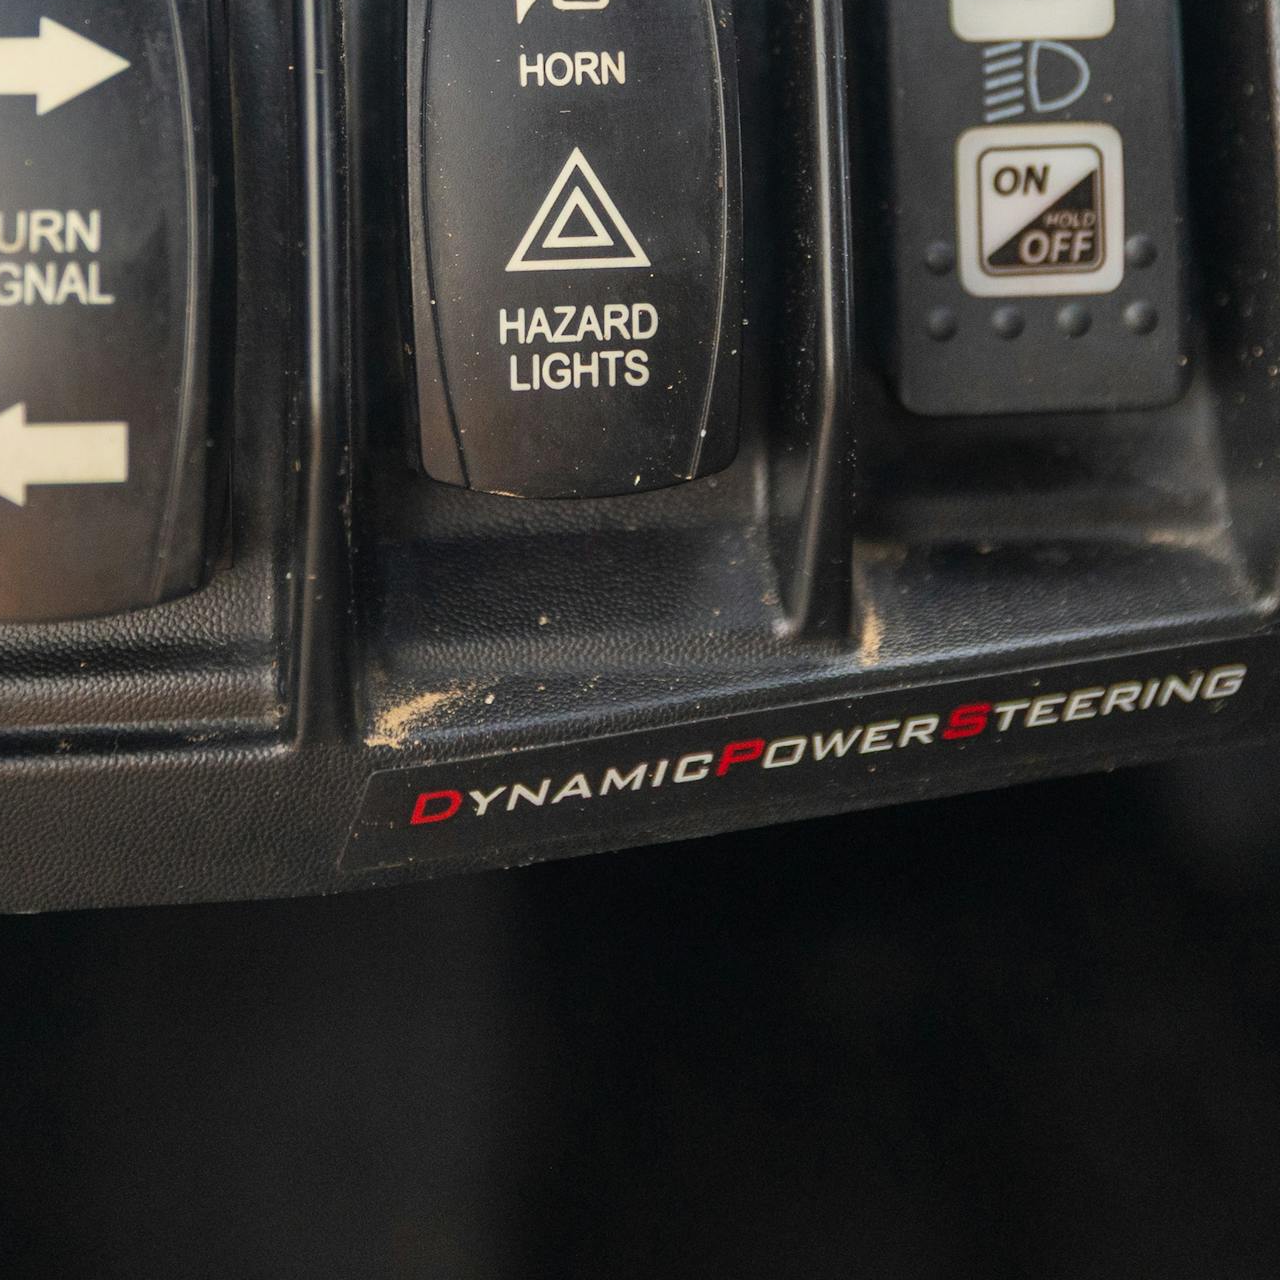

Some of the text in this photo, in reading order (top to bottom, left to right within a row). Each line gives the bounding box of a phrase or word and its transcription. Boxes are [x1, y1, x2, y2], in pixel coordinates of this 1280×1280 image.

[520, 50, 626, 87] HORN
[993, 165, 1050, 196] ON
[1019, 228, 1094, 264] OFF
[500, 303, 659, 344] HAZARD
[510, 349, 650, 392] LIGHTS
